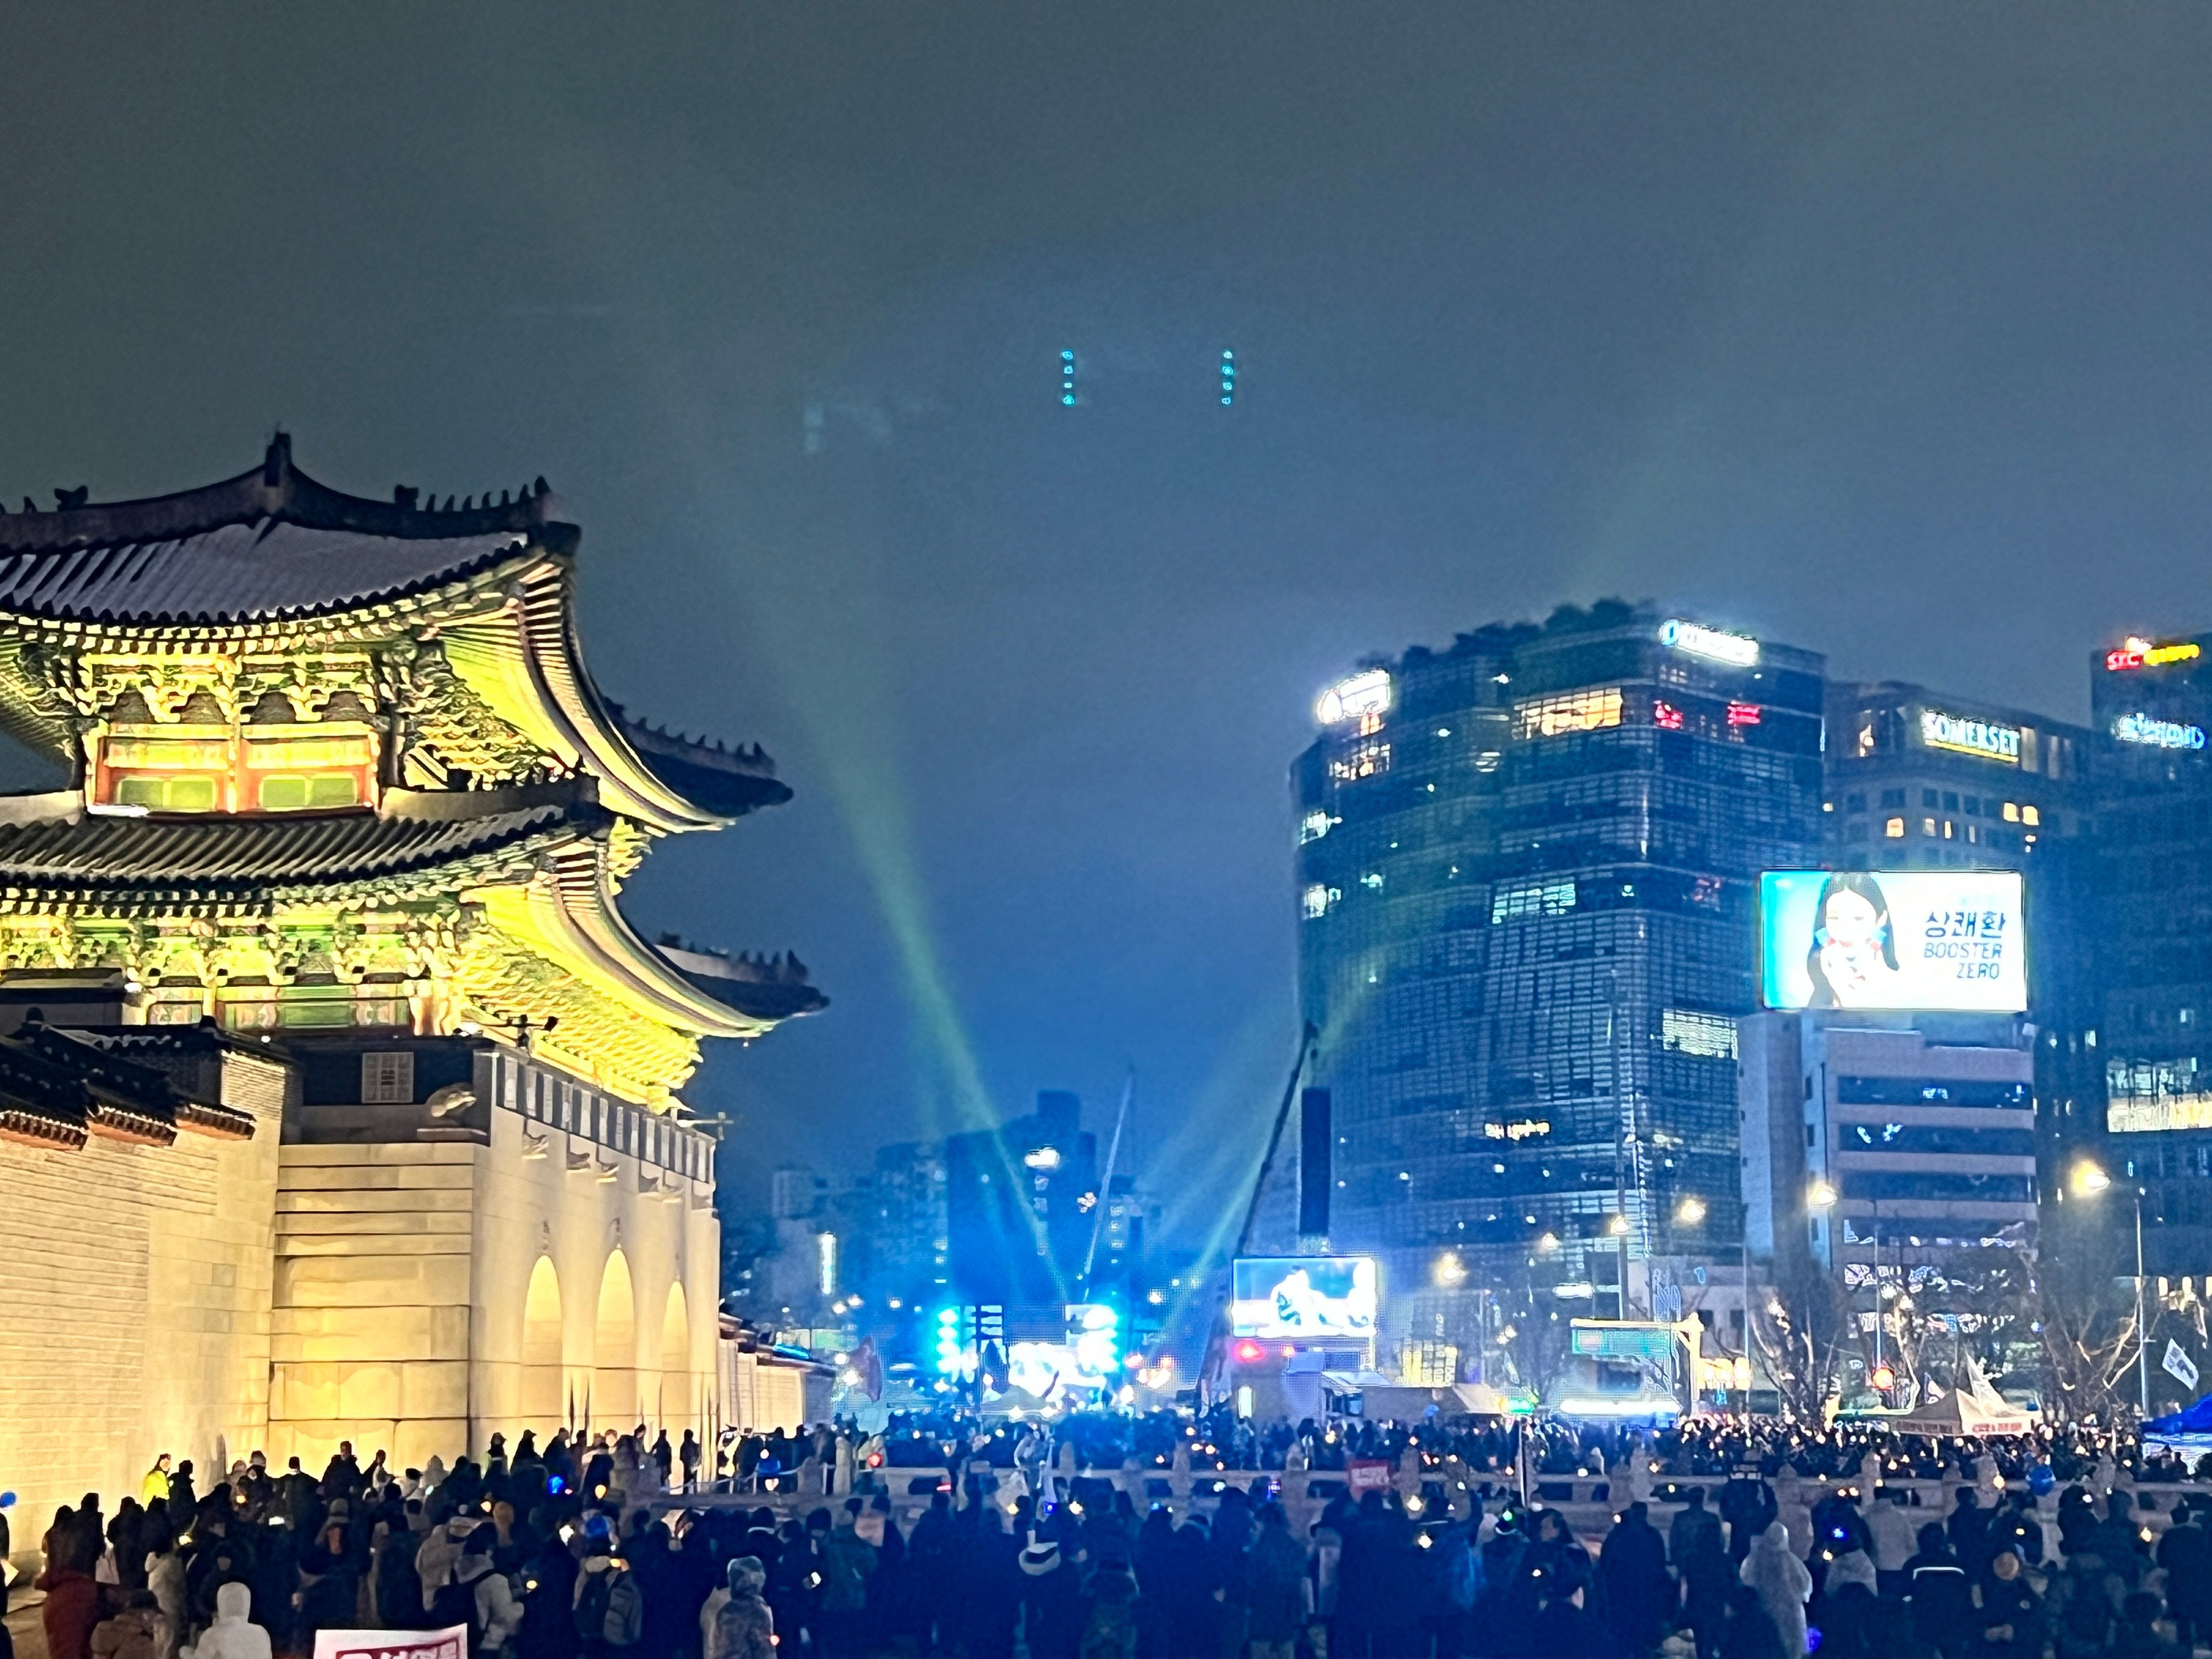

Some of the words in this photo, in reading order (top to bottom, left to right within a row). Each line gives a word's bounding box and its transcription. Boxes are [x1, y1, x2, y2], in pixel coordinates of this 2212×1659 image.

[1922, 713, 2019, 756] SOMERSET
[1924, 943, 2002, 959] BOOSTER
[1957, 963, 1999, 979] ZERO
